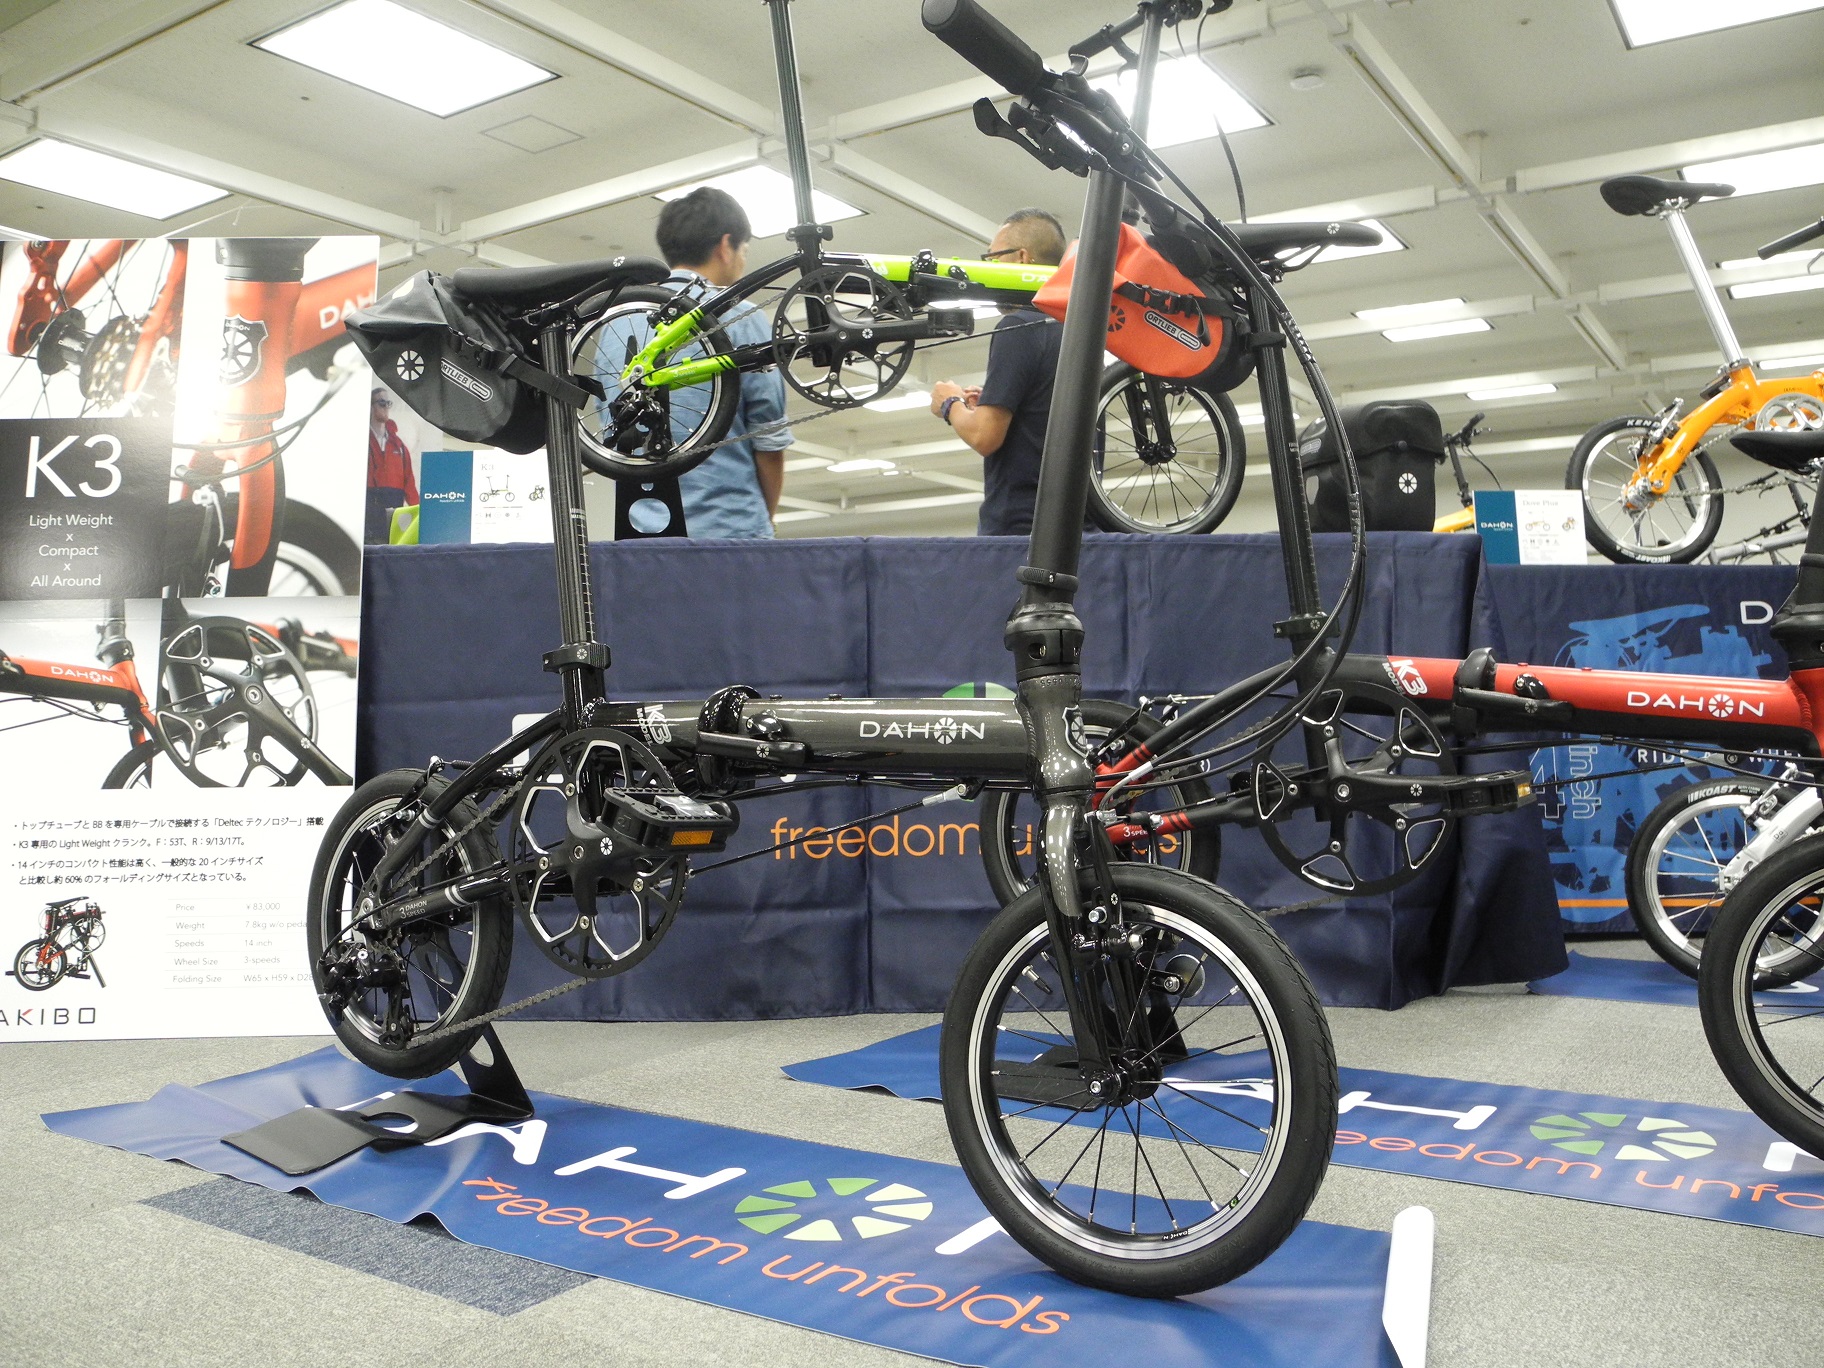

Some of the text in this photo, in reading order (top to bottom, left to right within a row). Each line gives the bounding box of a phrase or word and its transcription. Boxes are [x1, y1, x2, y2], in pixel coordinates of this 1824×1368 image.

[1147, 313, 1177, 335] ORTLIEB
[441, 362, 469, 385] RTLIEB
[25, 434, 122, 499] K3
[424, 491, 466, 500] DAHON
[29, 513, 113, 529] Light Weight
[1481, 521, 1514, 529] DAHON
[38, 544, 99, 559] Compact
[31, 575, 102, 587] All Around
[51, 665, 114, 684] DAHON
[1391, 659, 1428, 696] K3
[1626, 691, 1764, 718] DAHON
[636, 707, 654, 747] MODEL
[644, 703, 673, 745] K3
[859, 717, 986, 745] DAHON
[1569, 744, 1602, 820] inch
[1697, 784, 1738, 800] KOAST
[771, 815, 981, 860] freedom
[1123, 826, 1131, 837] 3
[18, 840, 29, 849] K3
[31, 839, 57, 849] 専用の
[59, 839, 80, 850] Light
[82, 838, 110, 850] Weight
[18, 861, 27, 869] 14
[198, 857, 209, 866] 20
[210, 856, 263, 866] インチサイズ
[19, 872, 247, 885] と比較し約 60% のフォールディングサイズとなっている。
[175, 903, 195, 911] Price
[252, 902, 281, 911] 83,000
[398, 900, 427, 919] 3 DAHON
[406, 908, 426, 918] SPEED
[175, 921, 205, 931] Weight
[269, 920, 285, 928] w/o
[174, 939, 273, 949] Speeds 14 inch
[174, 956, 281, 966] Wheel Size 3-speeds
[172, 975, 204, 984] Folding
[206, 975, 222, 983] Size
[243, 974, 262, 982] W65
[271, 974, 288, 982] H59
[462, 1175, 749, 1267] freedom
[761, 1254, 1070, 1335] unfolds
